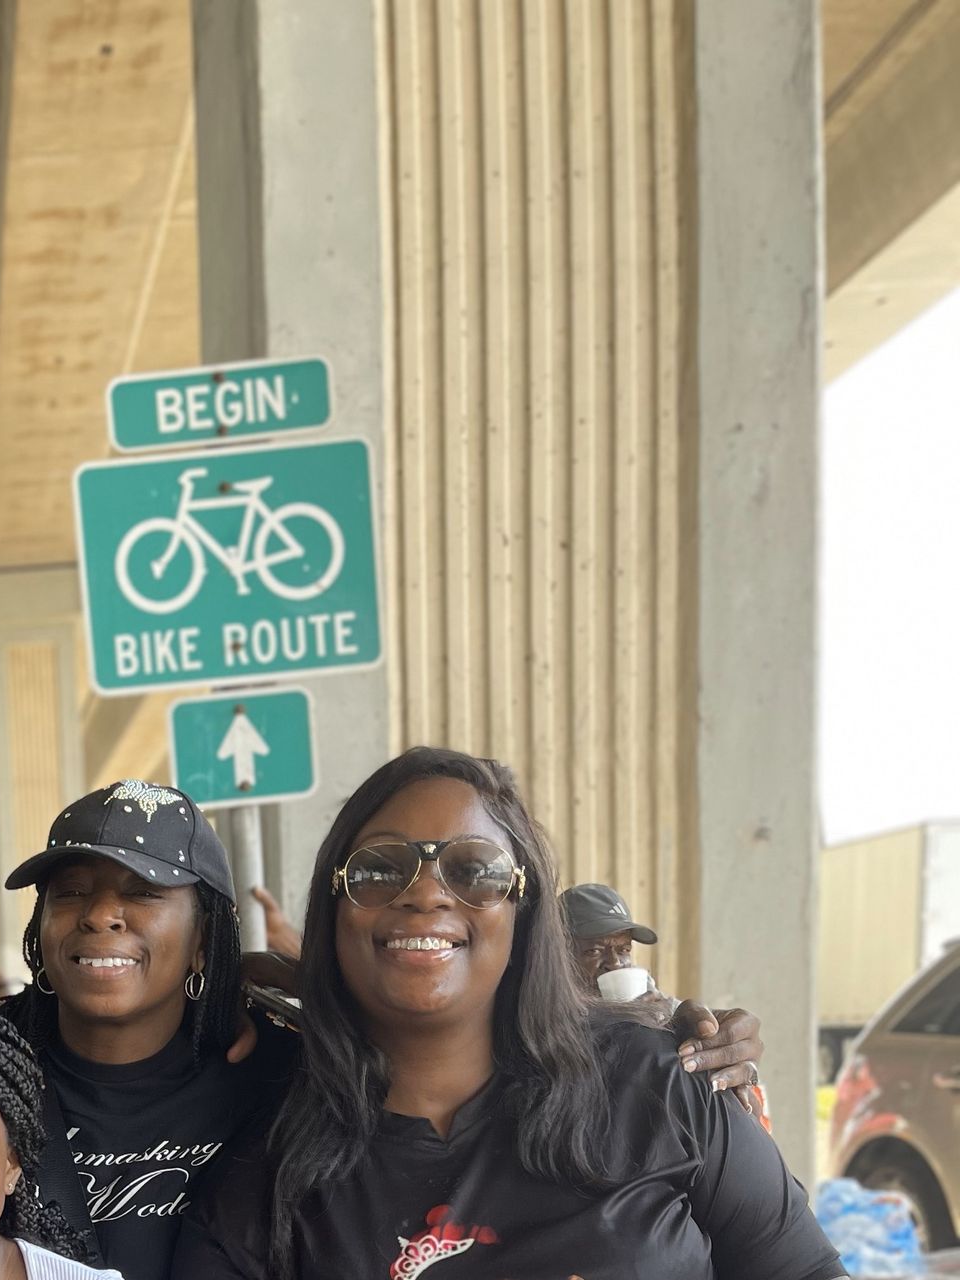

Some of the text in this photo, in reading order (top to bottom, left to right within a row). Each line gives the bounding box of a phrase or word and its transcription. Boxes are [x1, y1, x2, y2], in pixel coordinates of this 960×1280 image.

[155, 375, 286, 434] BEGIN
[114, 612, 359, 677] BIKE ROUTE
[67, 1128, 223, 1166] nmasking
